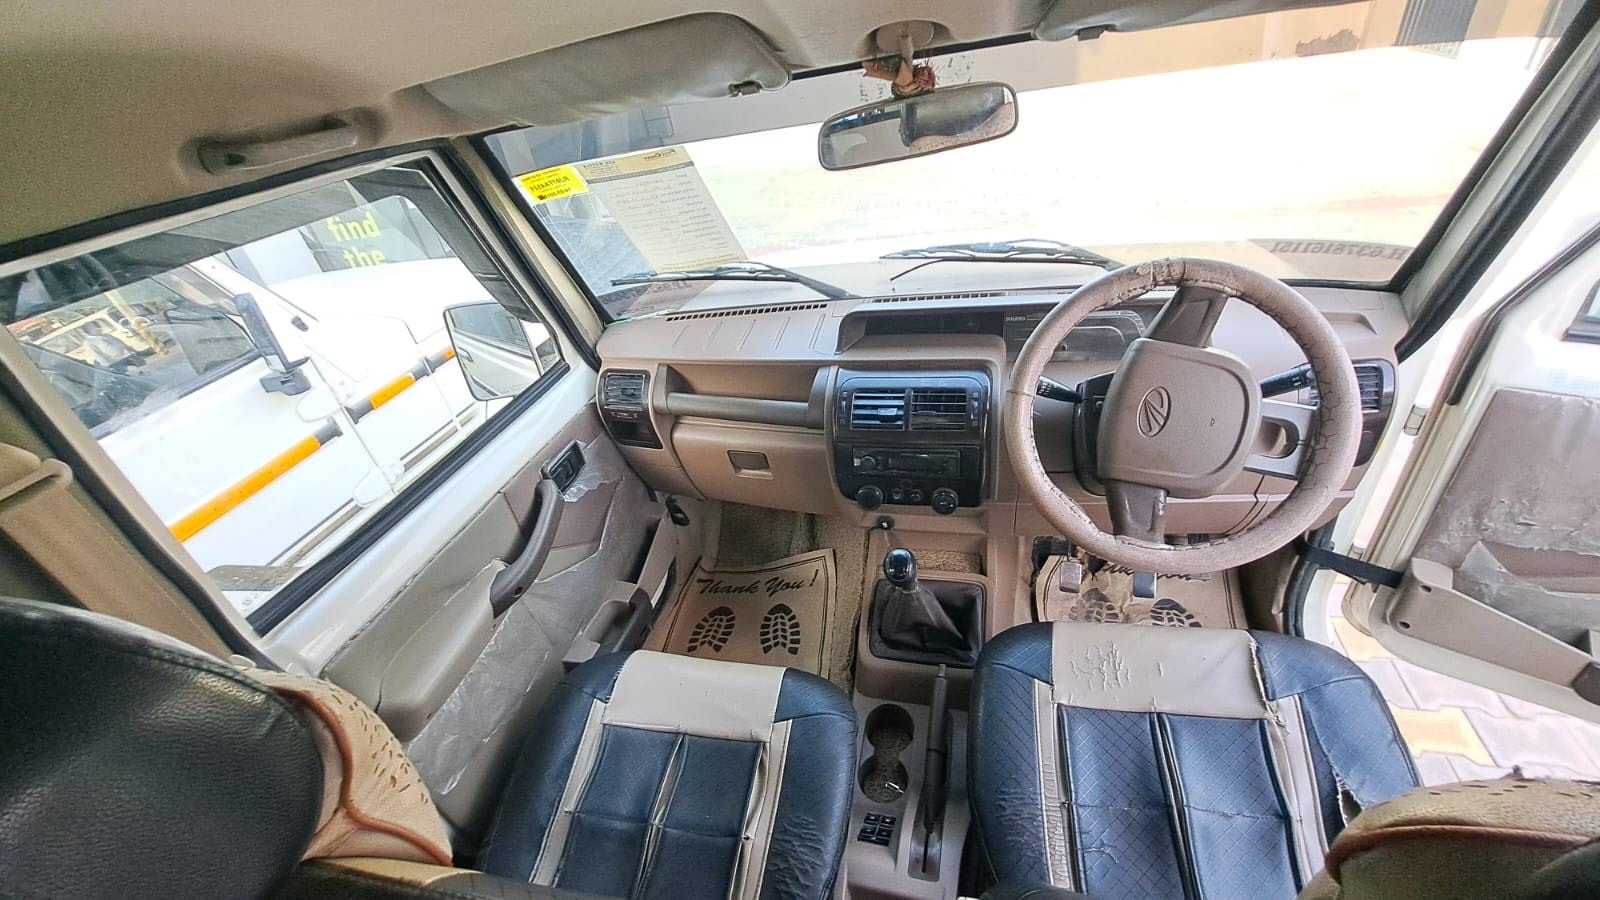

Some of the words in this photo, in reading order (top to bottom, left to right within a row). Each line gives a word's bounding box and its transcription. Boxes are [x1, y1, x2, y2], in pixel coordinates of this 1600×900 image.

[326, 211, 382, 242] find
[342, 245, 386, 269] the
[696, 578, 761, 595] Thank
